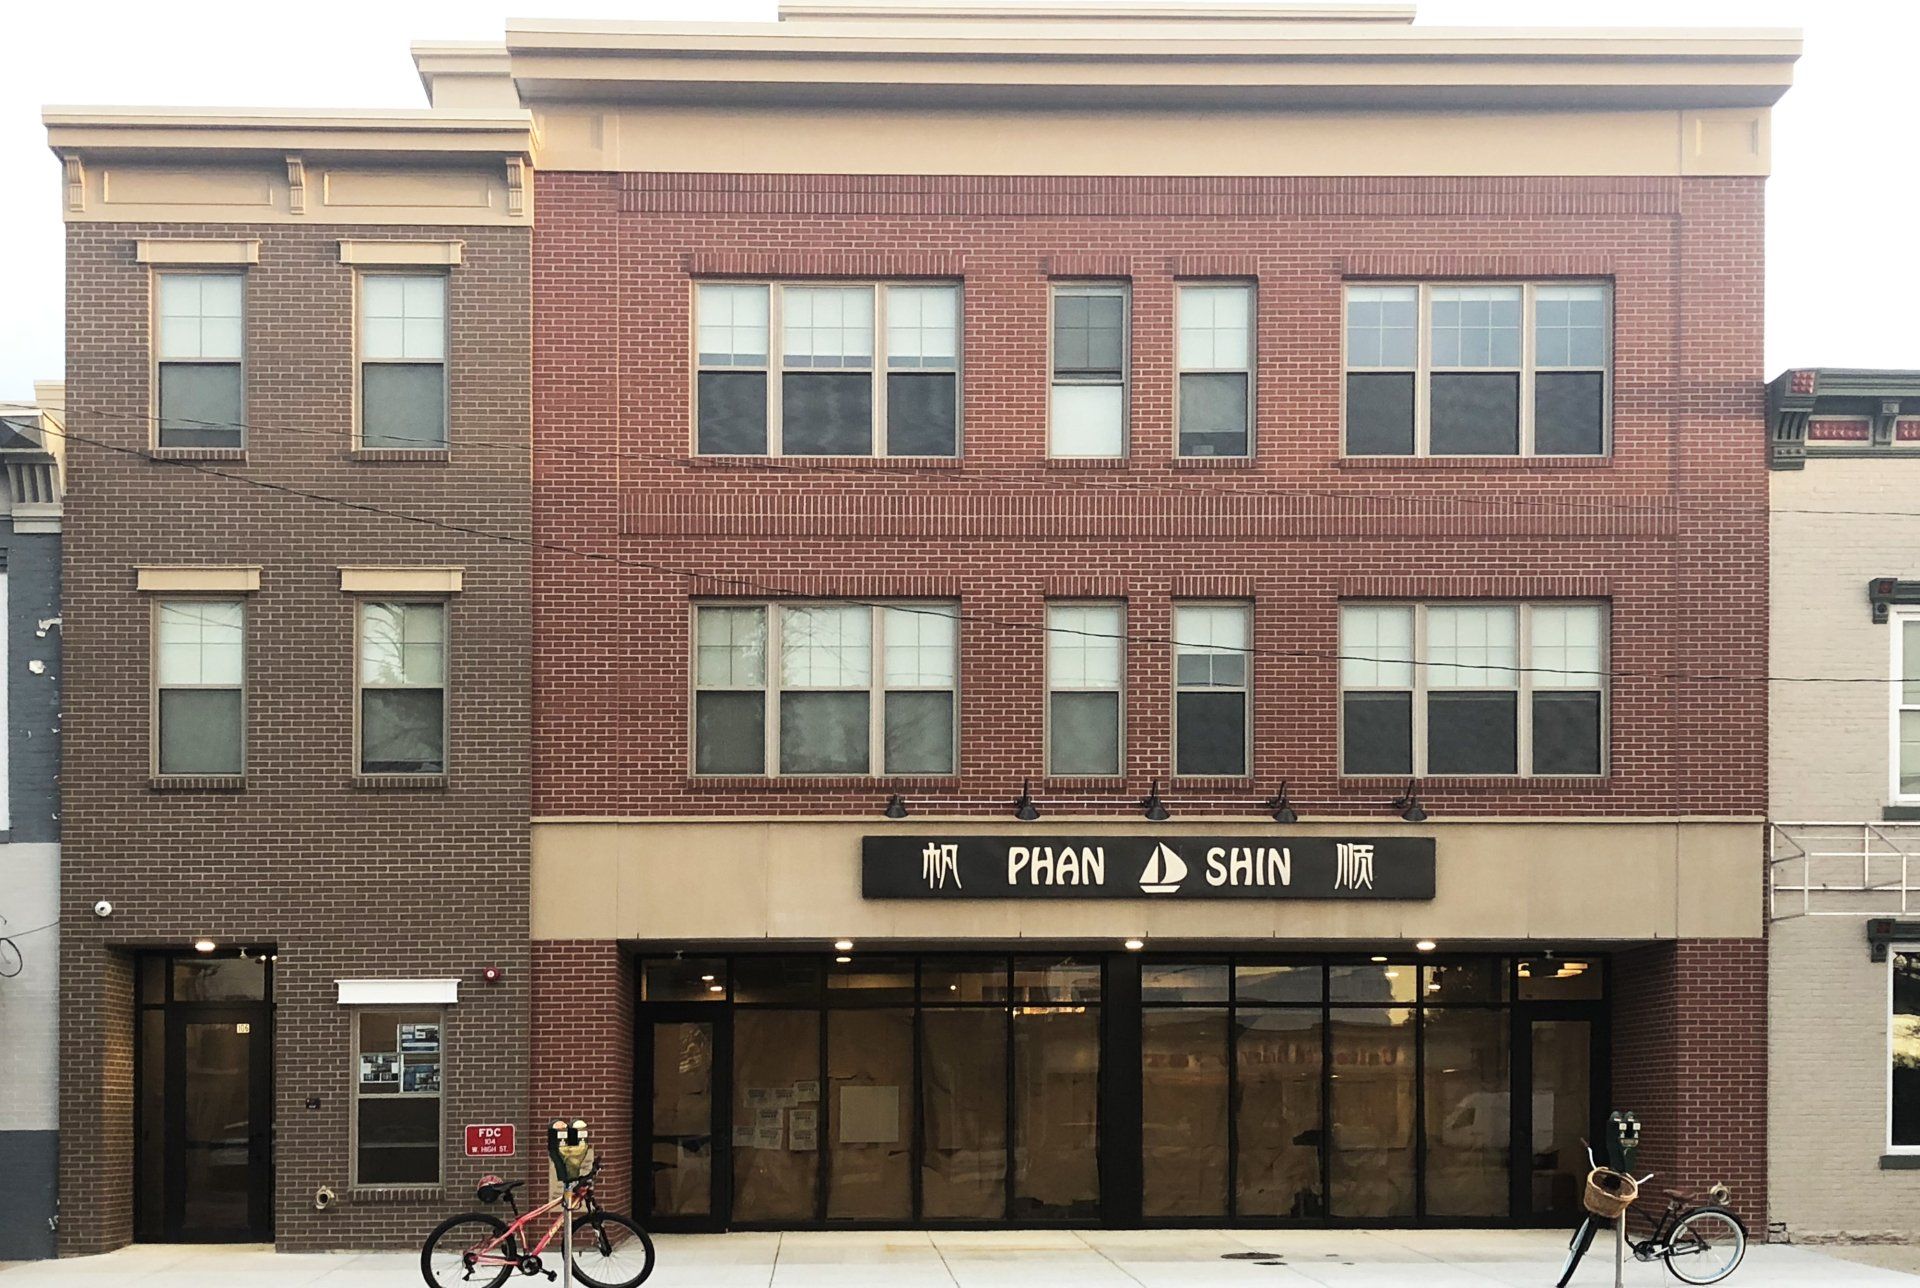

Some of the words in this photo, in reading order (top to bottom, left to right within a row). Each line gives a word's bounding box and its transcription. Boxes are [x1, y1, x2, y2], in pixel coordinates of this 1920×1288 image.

[922, 842, 962, 889] 帆
[1008, 846, 1105, 885] PHAN
[1205, 846, 1291, 886] SHIN
[1334, 843, 1374, 890] 顺
[478, 1127, 501, 1138] FDC
[480, 1145, 497, 1153] HIGH
